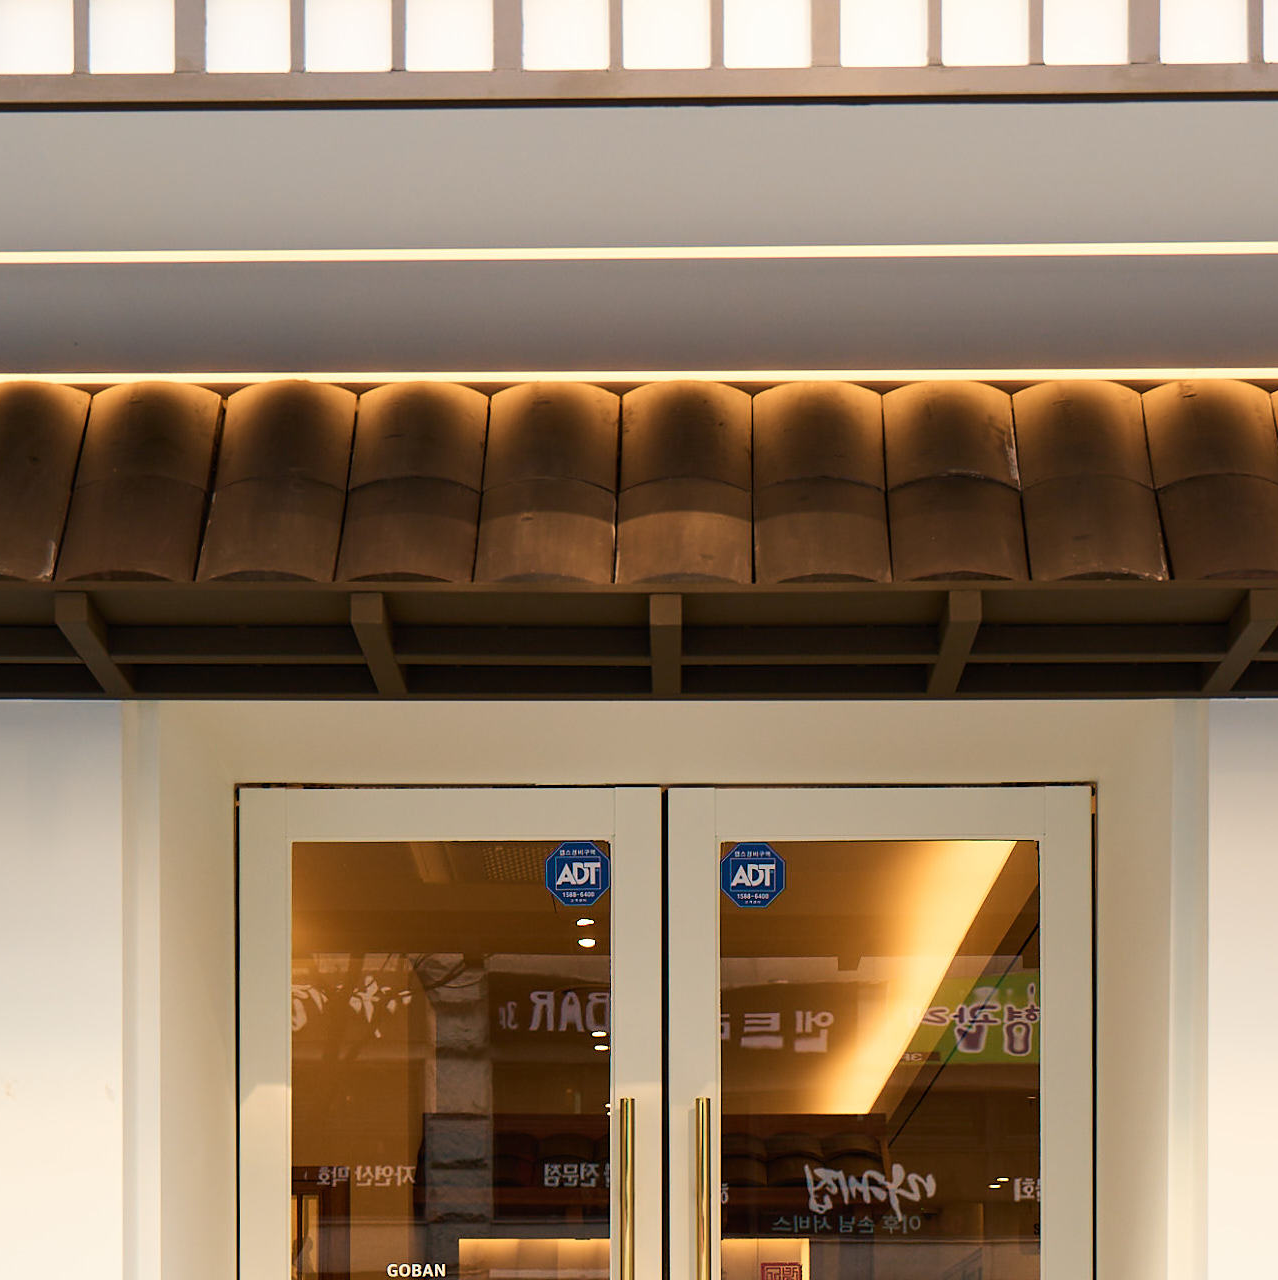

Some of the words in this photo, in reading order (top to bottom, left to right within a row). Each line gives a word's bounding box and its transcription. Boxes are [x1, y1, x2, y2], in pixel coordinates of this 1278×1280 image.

[556, 861, 601, 886] ADT
[731, 863, 776, 888] ADT
[562, 890, 595, 898] 1588-6400
[736, 892, 770, 900] 1588-6400
[386, 1263, 446, 1278] GOBAN
